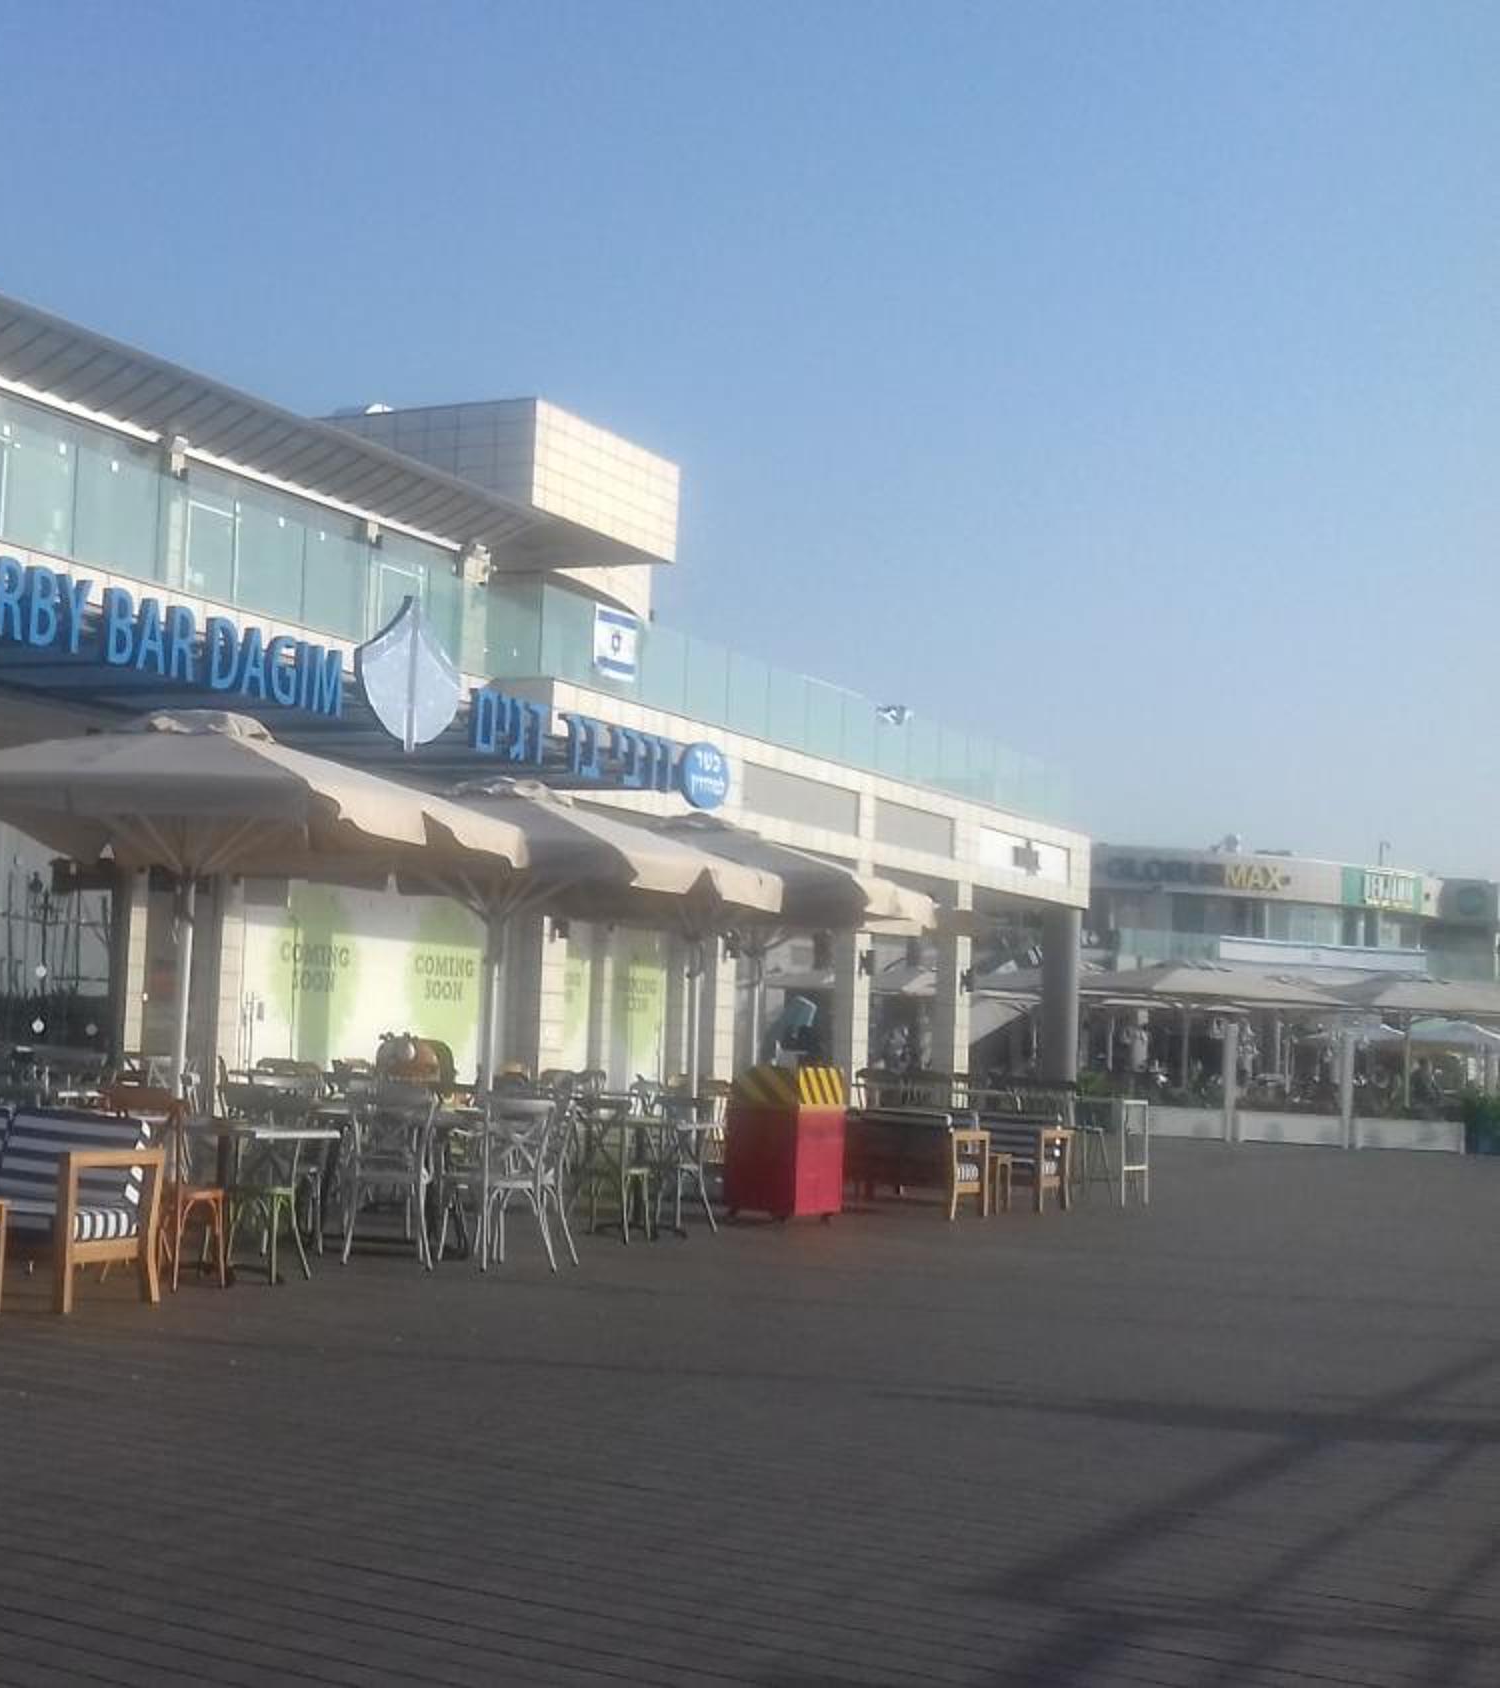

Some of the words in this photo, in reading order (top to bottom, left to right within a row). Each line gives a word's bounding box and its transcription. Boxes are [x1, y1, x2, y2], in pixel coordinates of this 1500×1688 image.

[102, 586, 197, 683] BAR
[204, 617, 343, 718] DAGIM
[469, 687, 550, 766] דגים
[560, 713, 602, 780] בר
[609, 727, 679, 792] דרבי
[1224, 863, 1283, 892] MAX
[281, 940, 350, 968] COMING
[414, 953, 475, 979] COMING
[291, 971, 335, 993] SOON
[424, 980, 463, 1002] SOON
